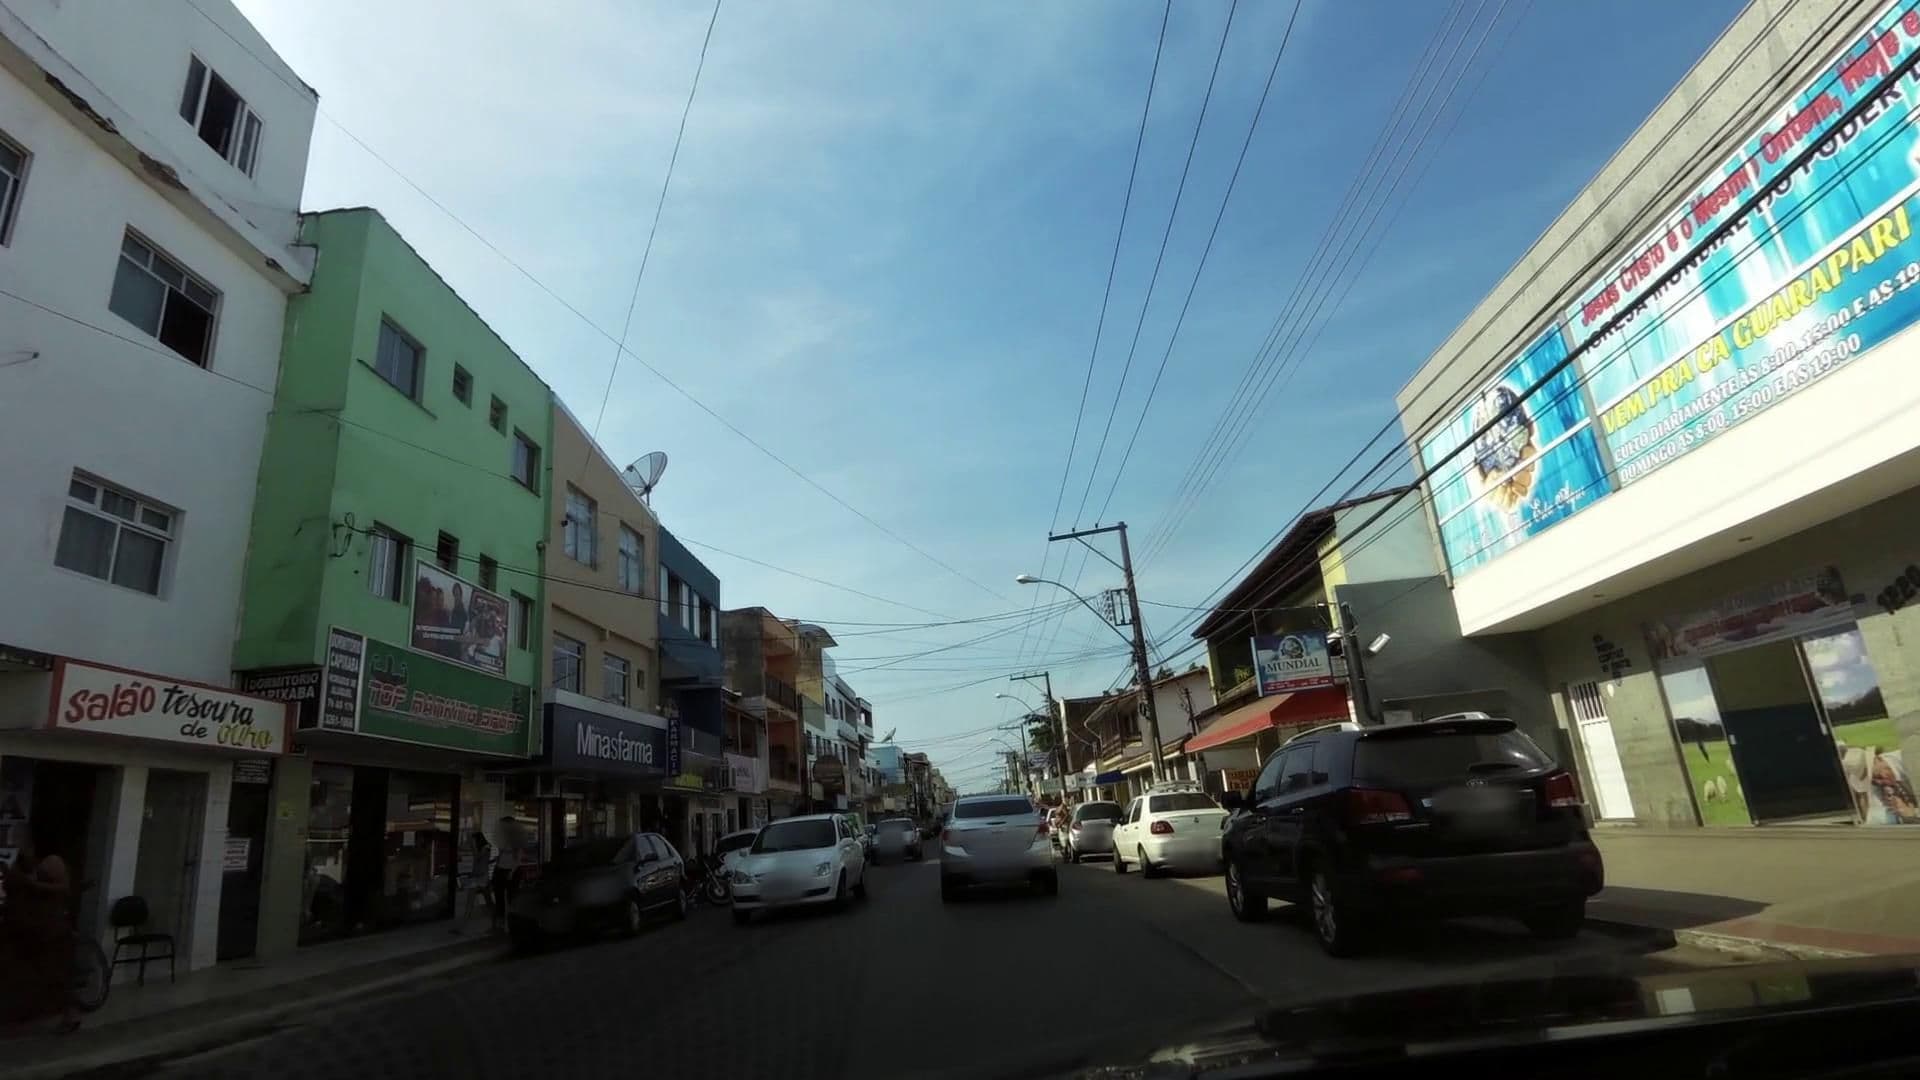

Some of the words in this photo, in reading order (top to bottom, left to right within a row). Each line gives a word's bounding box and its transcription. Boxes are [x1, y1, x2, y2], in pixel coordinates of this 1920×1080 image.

[1581, 283, 1620, 326] Jesus
[1620, 243, 1665, 292] Cristo
[1836, 30, 1900, 95] Hoje
[1602, 391, 1647, 435] VEM
[1648, 359, 1696, 408] PRA
[1733, 205, 1911, 349] GUARAPARI
[1621, 442, 1677, 481] DOMINGO
[1774, 376, 1787, 397] E
[1810, 333, 1861, 378] 19:00
[1650, 377, 1739, 443] DIARIAMENTE
[1852, 297, 1866, 319] E
[161, 685, 255, 725] tesoura
[1266, 658, 1321, 673] MUNDIAL
[180, 720, 208, 738] de
[216, 724, 272, 749] ouro
[576, 722, 653, 765] Minasfarma
